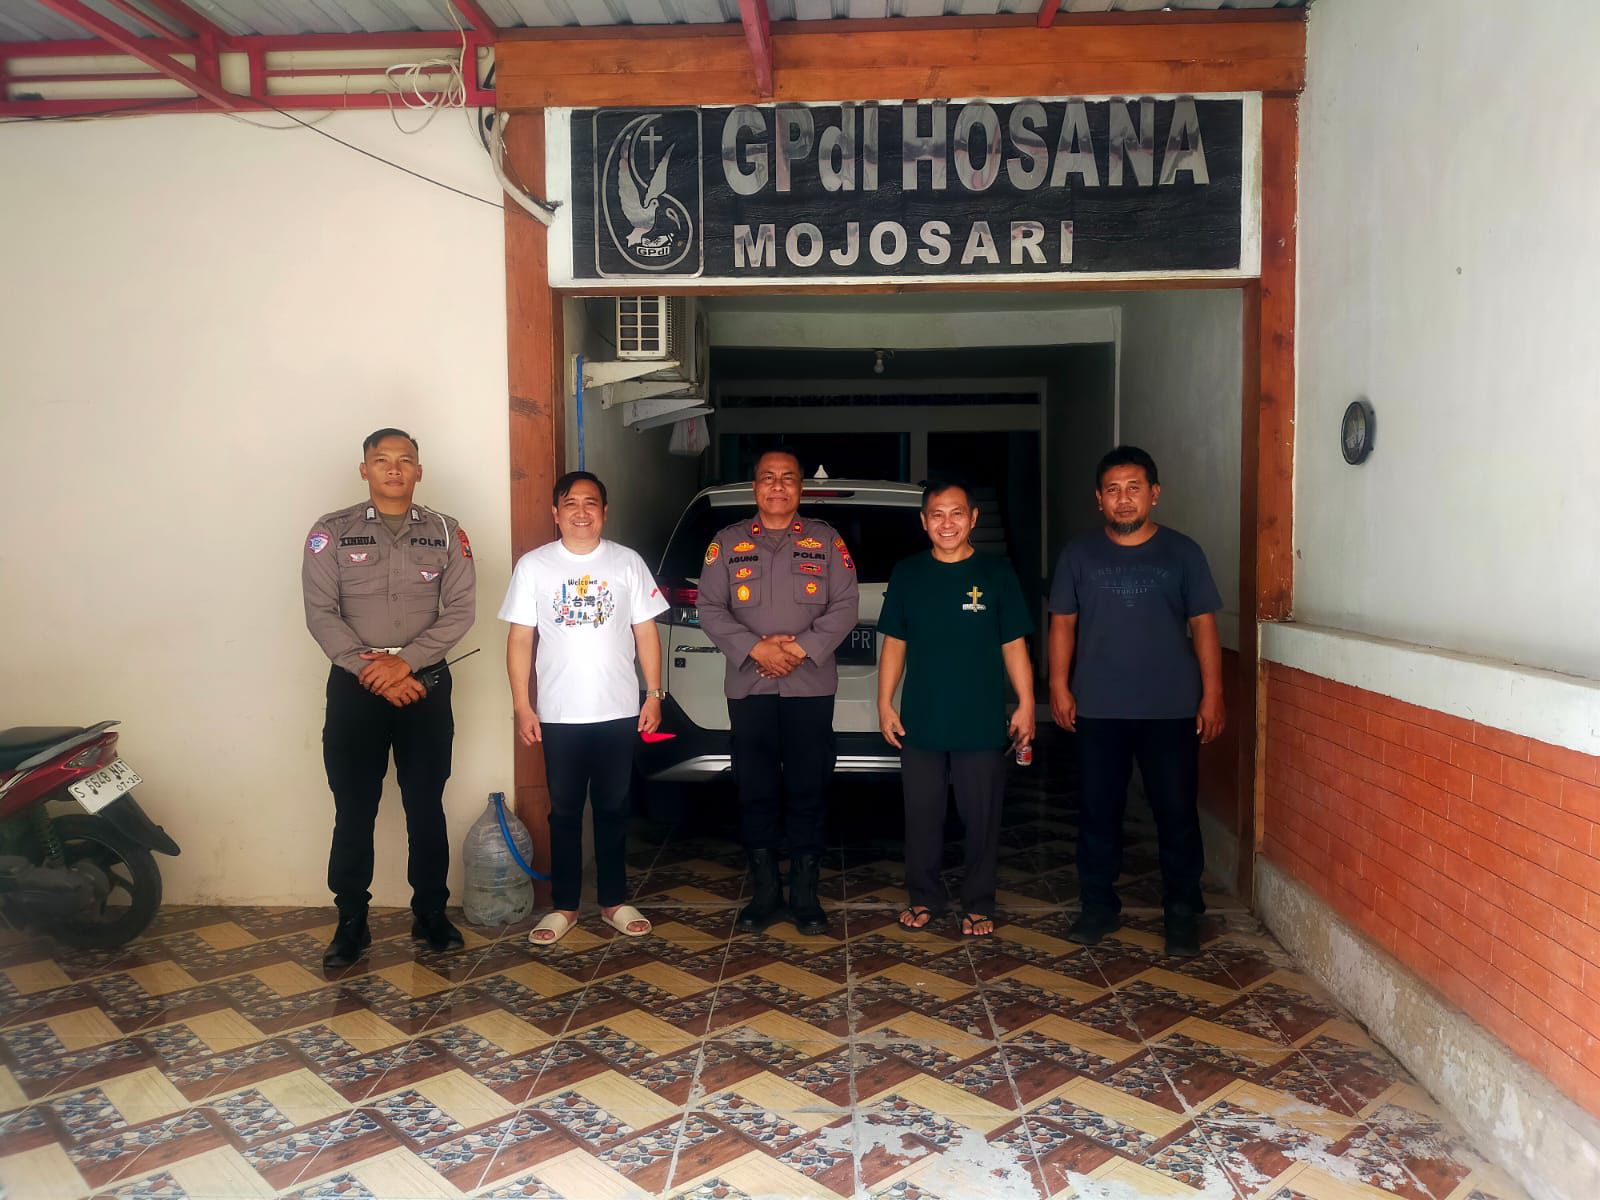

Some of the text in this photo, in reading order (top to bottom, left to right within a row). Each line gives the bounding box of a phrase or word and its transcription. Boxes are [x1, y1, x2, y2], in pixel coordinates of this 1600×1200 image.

[721, 97, 1210, 194] GPdI HOSANA
[734, 220, 1074, 268] MOJOSARI
[411, 538, 445, 547] POLRI
[729, 556, 759, 564] AGUNG
[793, 552, 825, 560] POLRI
[851, 631, 870, 649] PR
